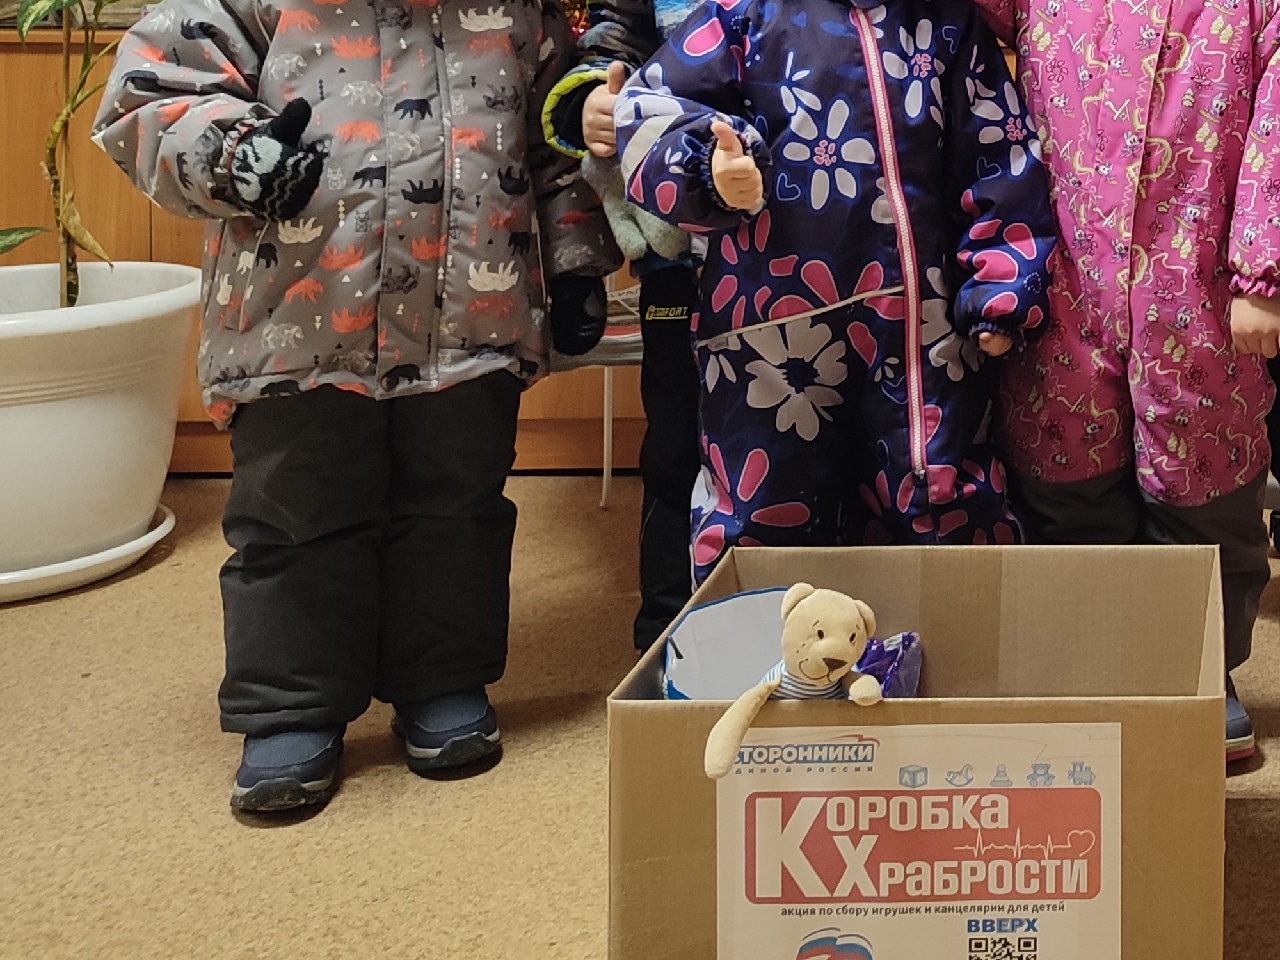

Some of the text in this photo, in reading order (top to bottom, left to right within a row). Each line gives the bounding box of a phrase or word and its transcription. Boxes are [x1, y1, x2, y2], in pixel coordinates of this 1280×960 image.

[736, 744, 873, 763] ТОРОННИКИ
[734, 766, 792, 774] ДИНОЙ
[781, 901, 1065, 917] акция по сбору игрушек и канцелярии для детей
[967, 918, 1039, 934] ВВЕРХ
